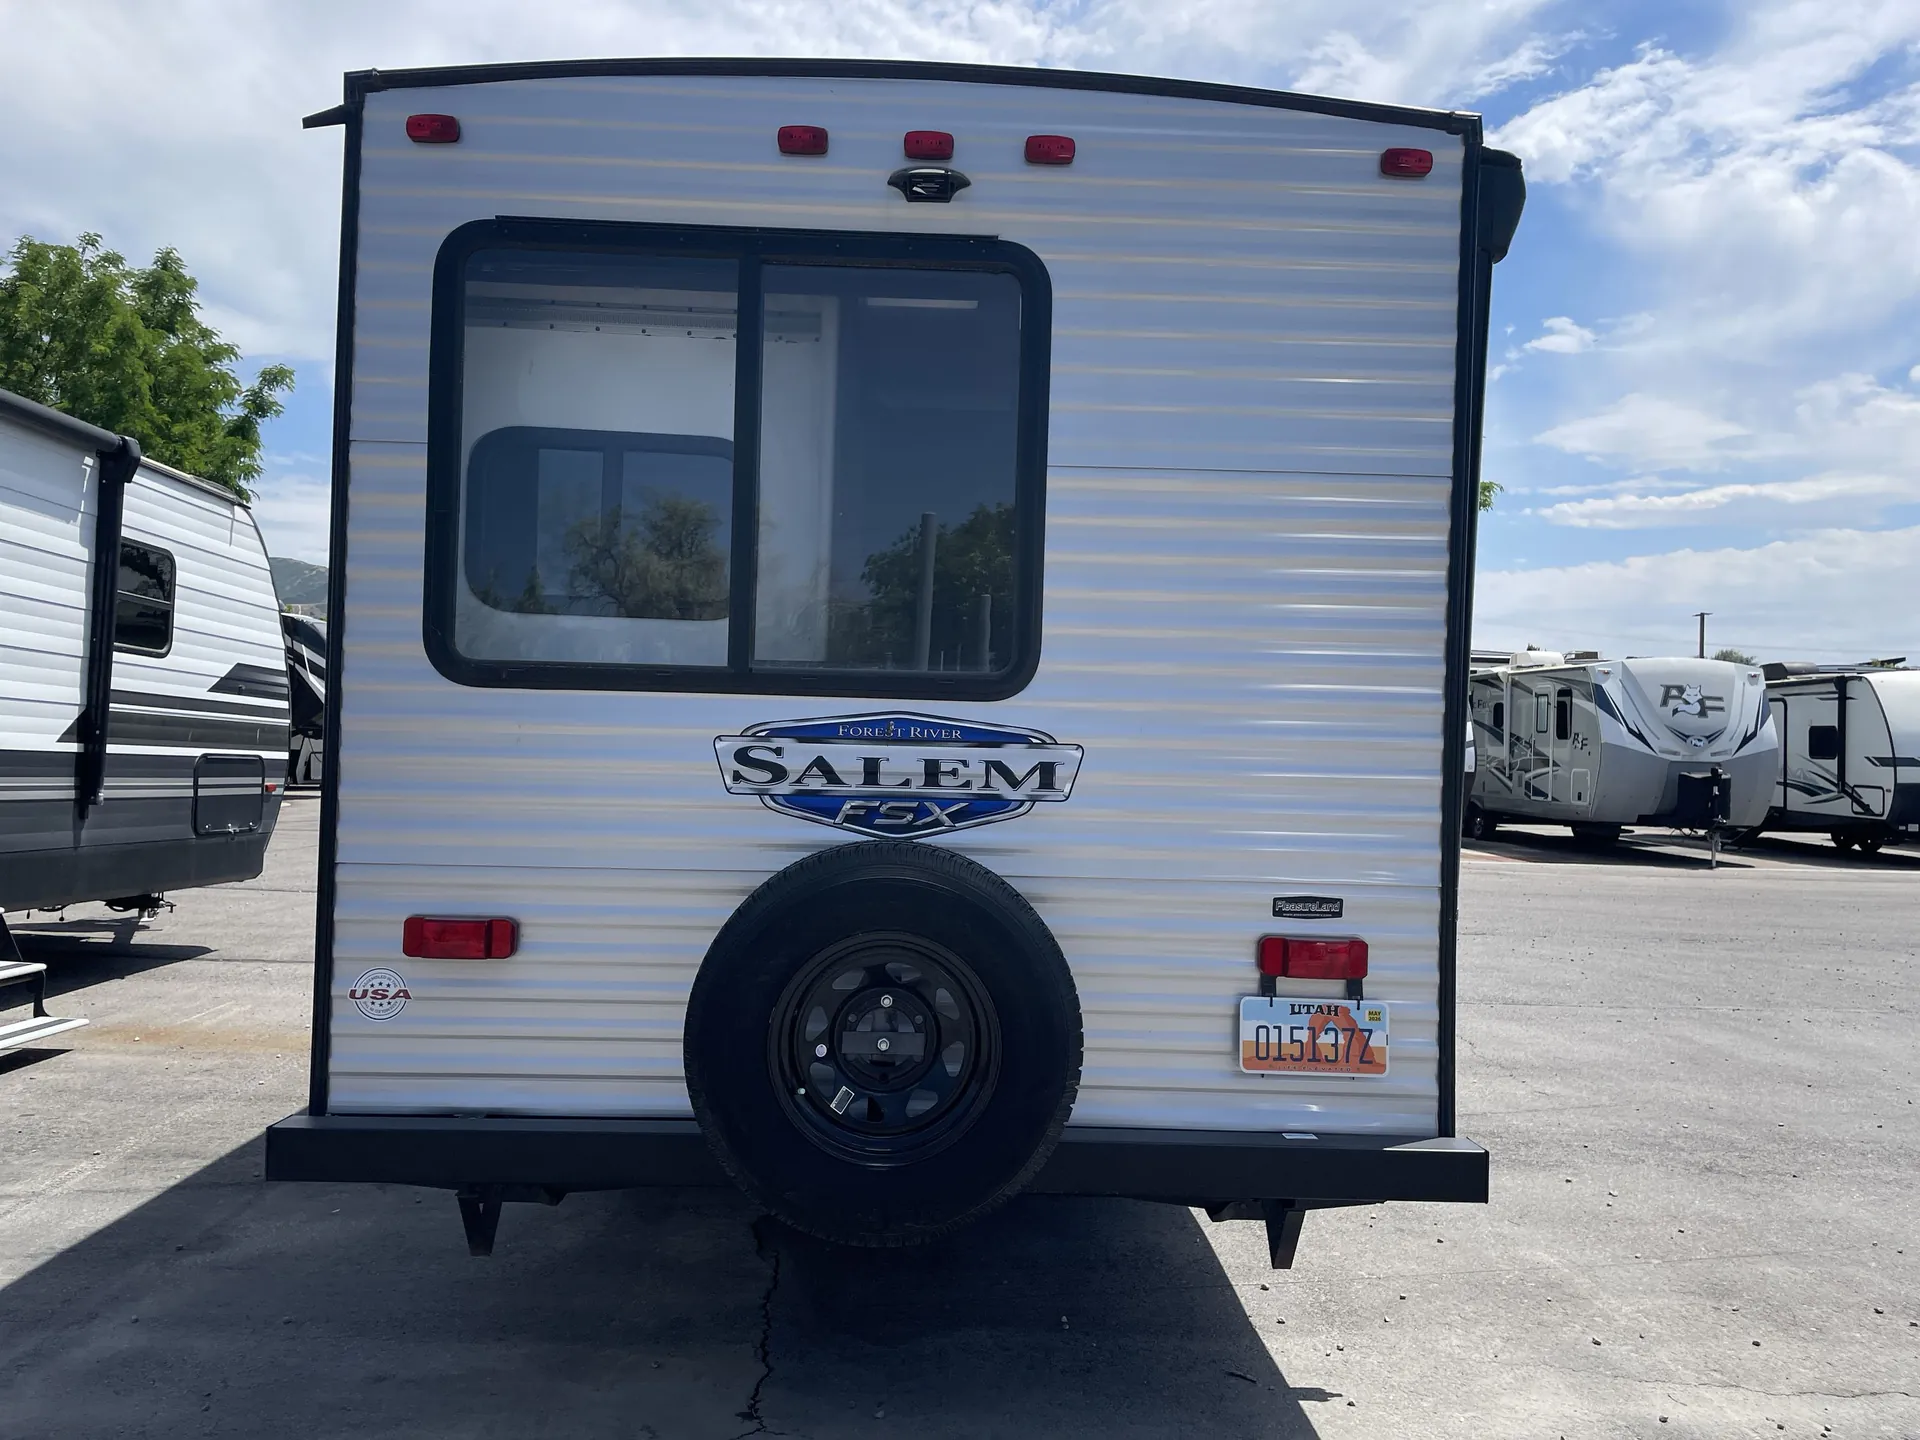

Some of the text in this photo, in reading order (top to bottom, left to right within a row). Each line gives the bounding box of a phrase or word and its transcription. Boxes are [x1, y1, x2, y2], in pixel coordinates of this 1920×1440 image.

[910, 726, 962, 739] RIVER
[732, 746, 1065, 792] SALEM
[833, 800, 970, 827] FSX
[349, 988, 412, 1000] USA
[1289, 1003, 1340, 1017] UTAH
[1255, 1025, 1374, 1064] 015137Z
